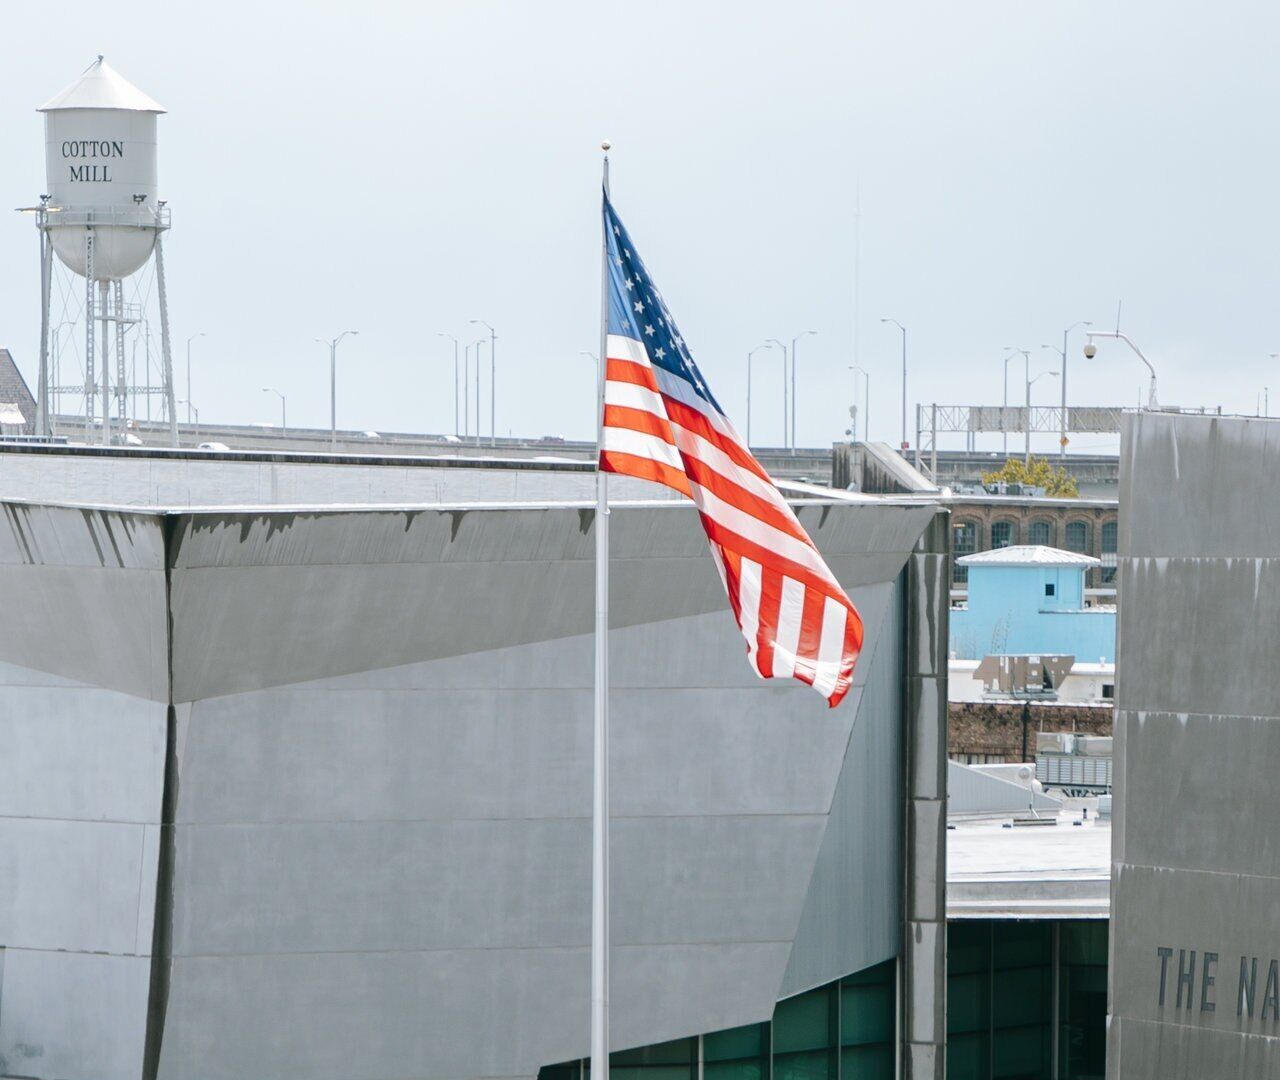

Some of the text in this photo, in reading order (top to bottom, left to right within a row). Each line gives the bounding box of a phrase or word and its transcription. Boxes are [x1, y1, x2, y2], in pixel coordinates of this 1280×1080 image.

[62, 140, 124, 158] COTTON
[69, 165, 112, 182] MILL
[1157, 946, 1219, 1012] THE
